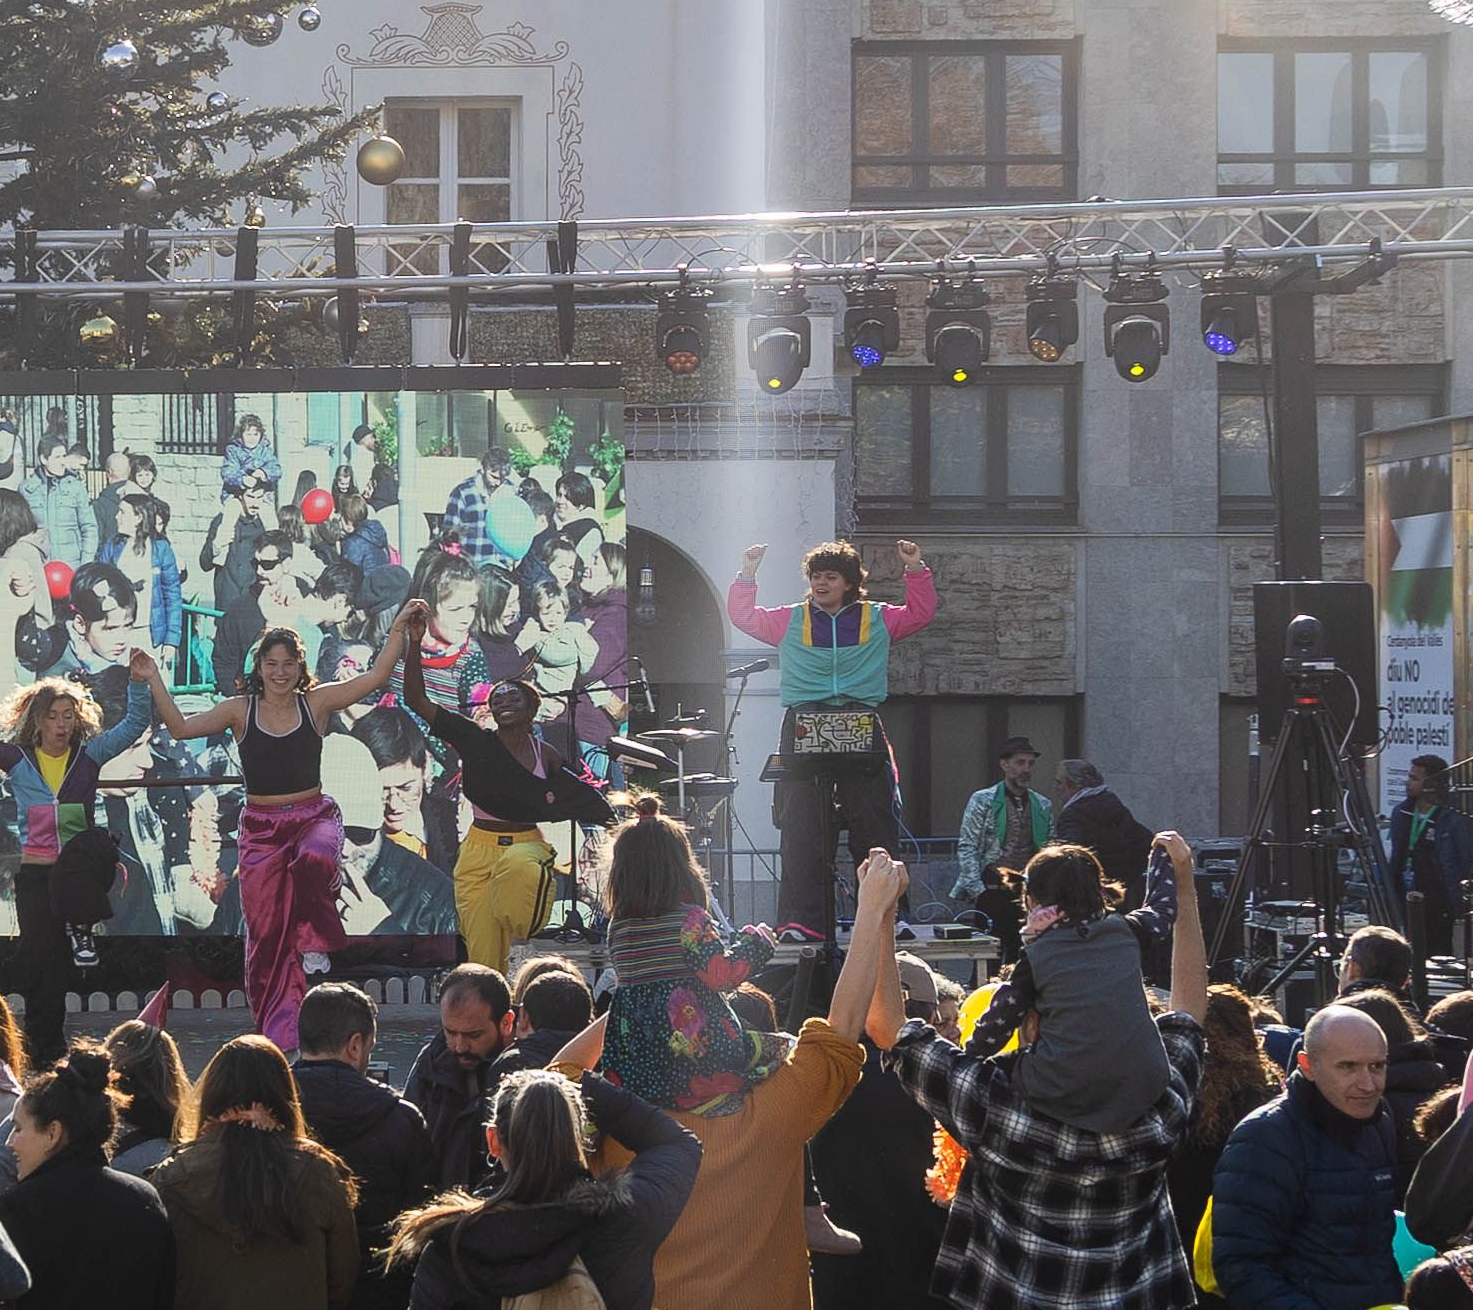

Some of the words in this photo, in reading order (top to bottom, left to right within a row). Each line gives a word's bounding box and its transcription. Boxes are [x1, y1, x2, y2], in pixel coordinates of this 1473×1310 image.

[1387, 658, 1402, 682] diu
[1404, 659, 1420, 682] NO
[1387, 691, 1396, 712] al
[1398, 690, 1440, 719] genocidi
[1416, 722, 1450, 751] palestí
